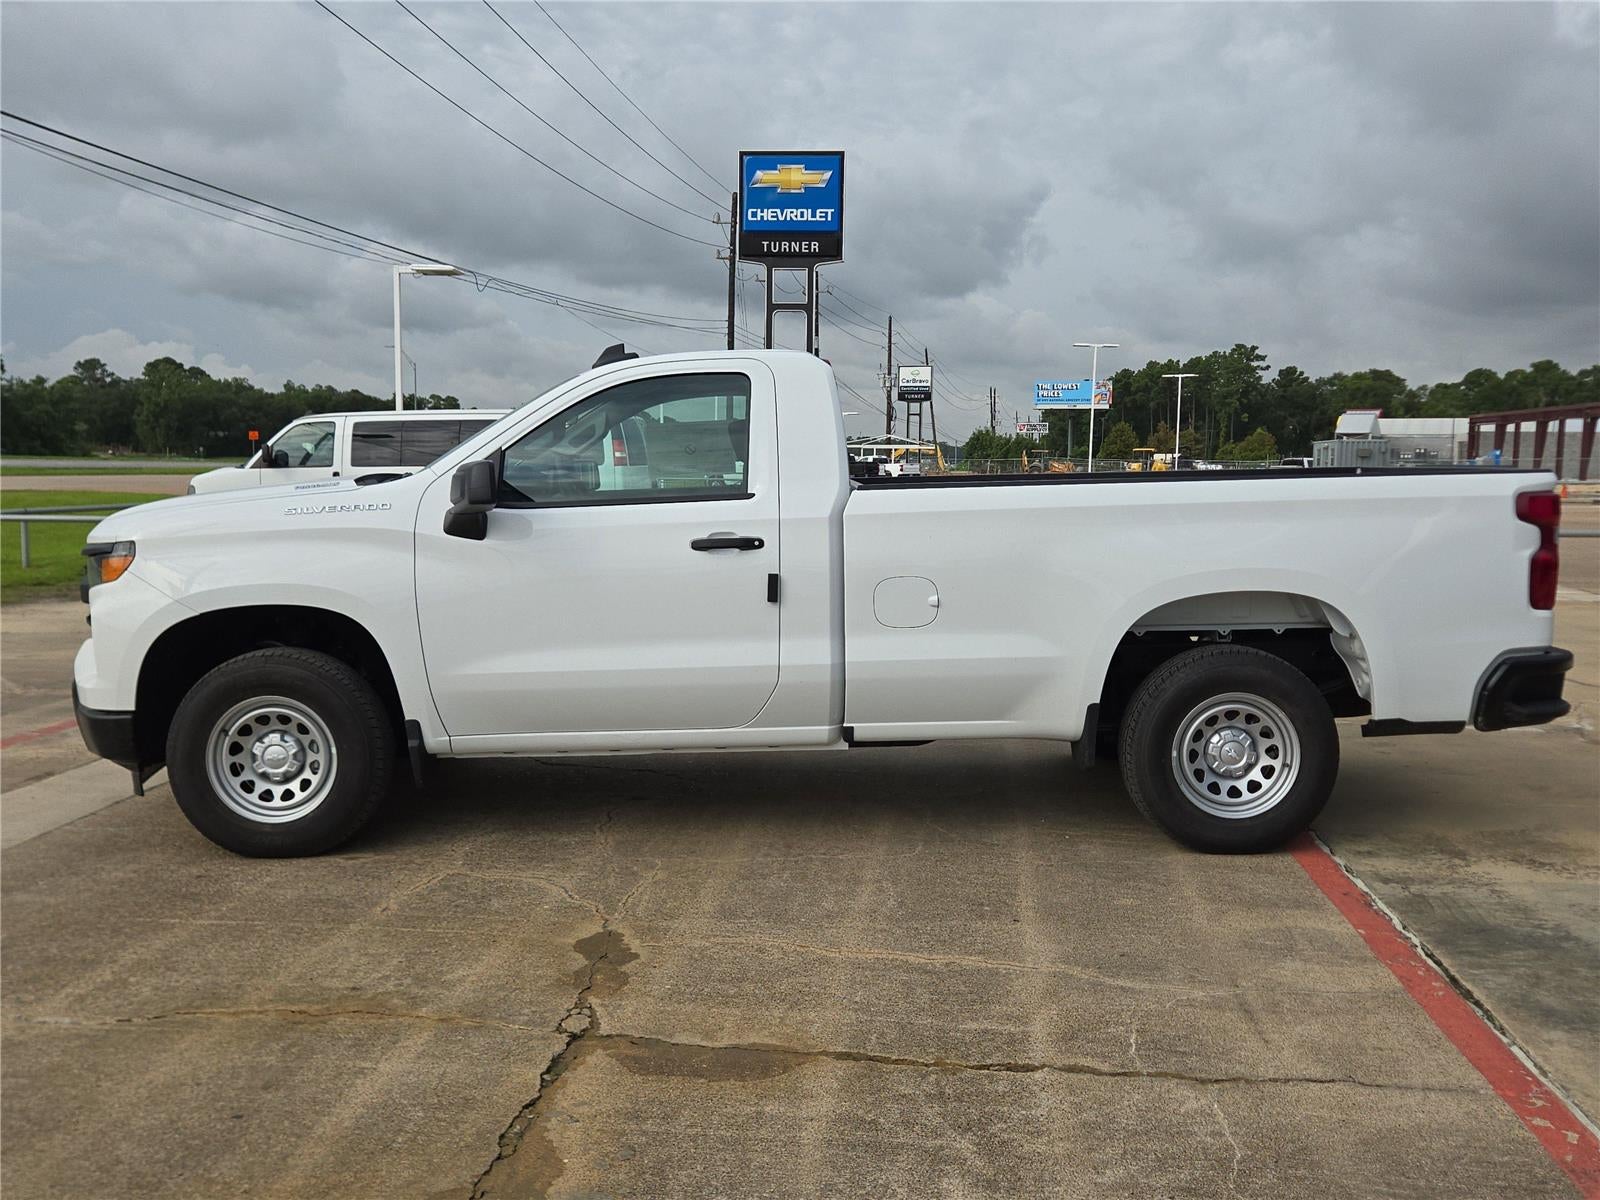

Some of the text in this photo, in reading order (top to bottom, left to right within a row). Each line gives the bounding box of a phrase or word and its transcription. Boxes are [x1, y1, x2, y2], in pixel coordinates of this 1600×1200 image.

[747, 208, 835, 221] CHEVROLET
[761, 241, 820, 253] TURNER
[1037, 390, 1063, 398] PRICES
[284, 502, 392, 516] SILVERADO
